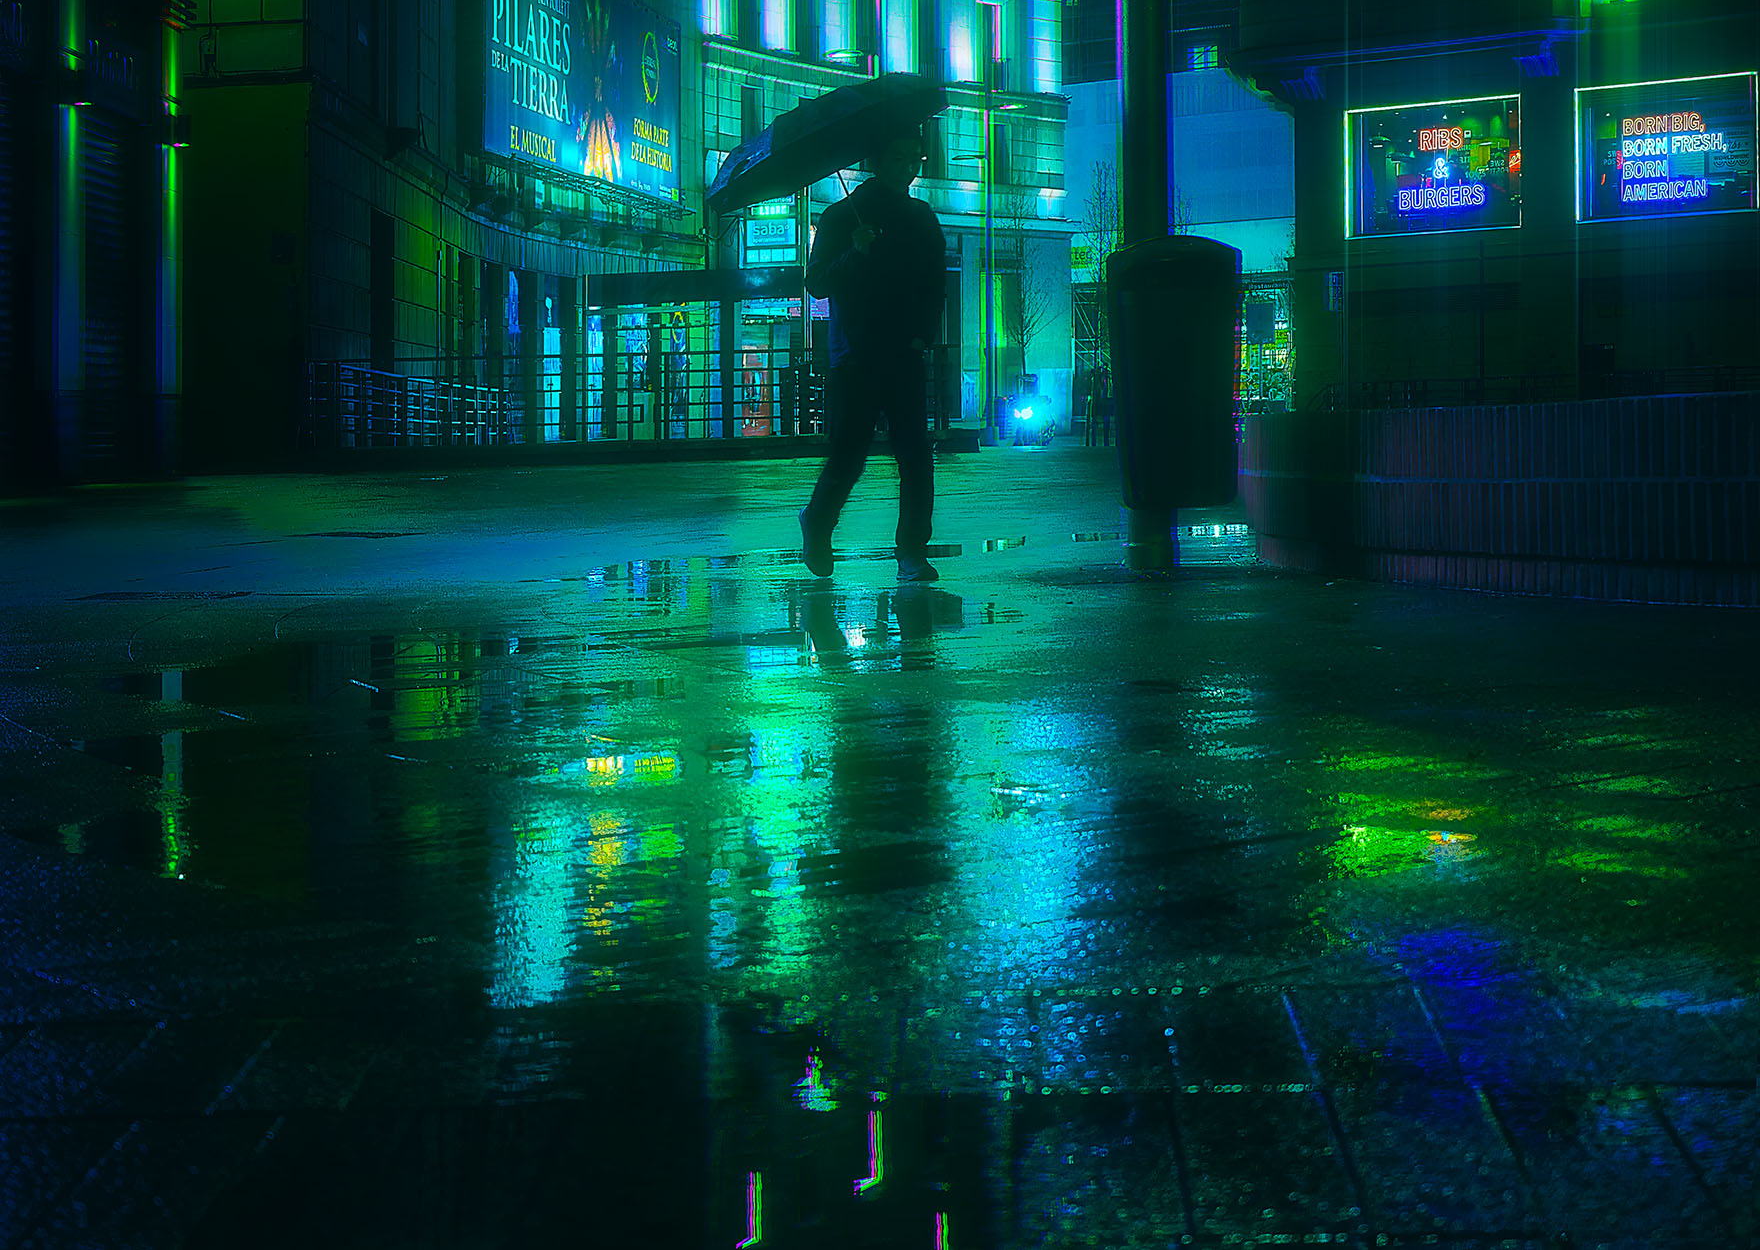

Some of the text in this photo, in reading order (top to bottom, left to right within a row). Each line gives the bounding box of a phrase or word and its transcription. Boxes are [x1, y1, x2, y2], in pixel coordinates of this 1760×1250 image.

[491, 49, 510, 73] DE LA
[510, 56, 571, 125] TIERRA
[633, 117, 669, 148] FORMA PARTE
[1622, 112, 1706, 136] BORN BIG,
[510, 125, 557, 162] EL MUSICAL
[1419, 127, 1463, 151] RIBS
[1622, 136, 1668, 157] BORN
[1671, 132, 1727, 154] FRESH,
[631, 141, 673, 172] DE LA HISTORIA
[1433, 157, 1448, 179] &
[1622, 159, 1667, 180] BORN
[1398, 184, 1485, 211] BURGERS
[1622, 179, 1706, 202] AMERICAN
[752, 221, 785, 236] saba
